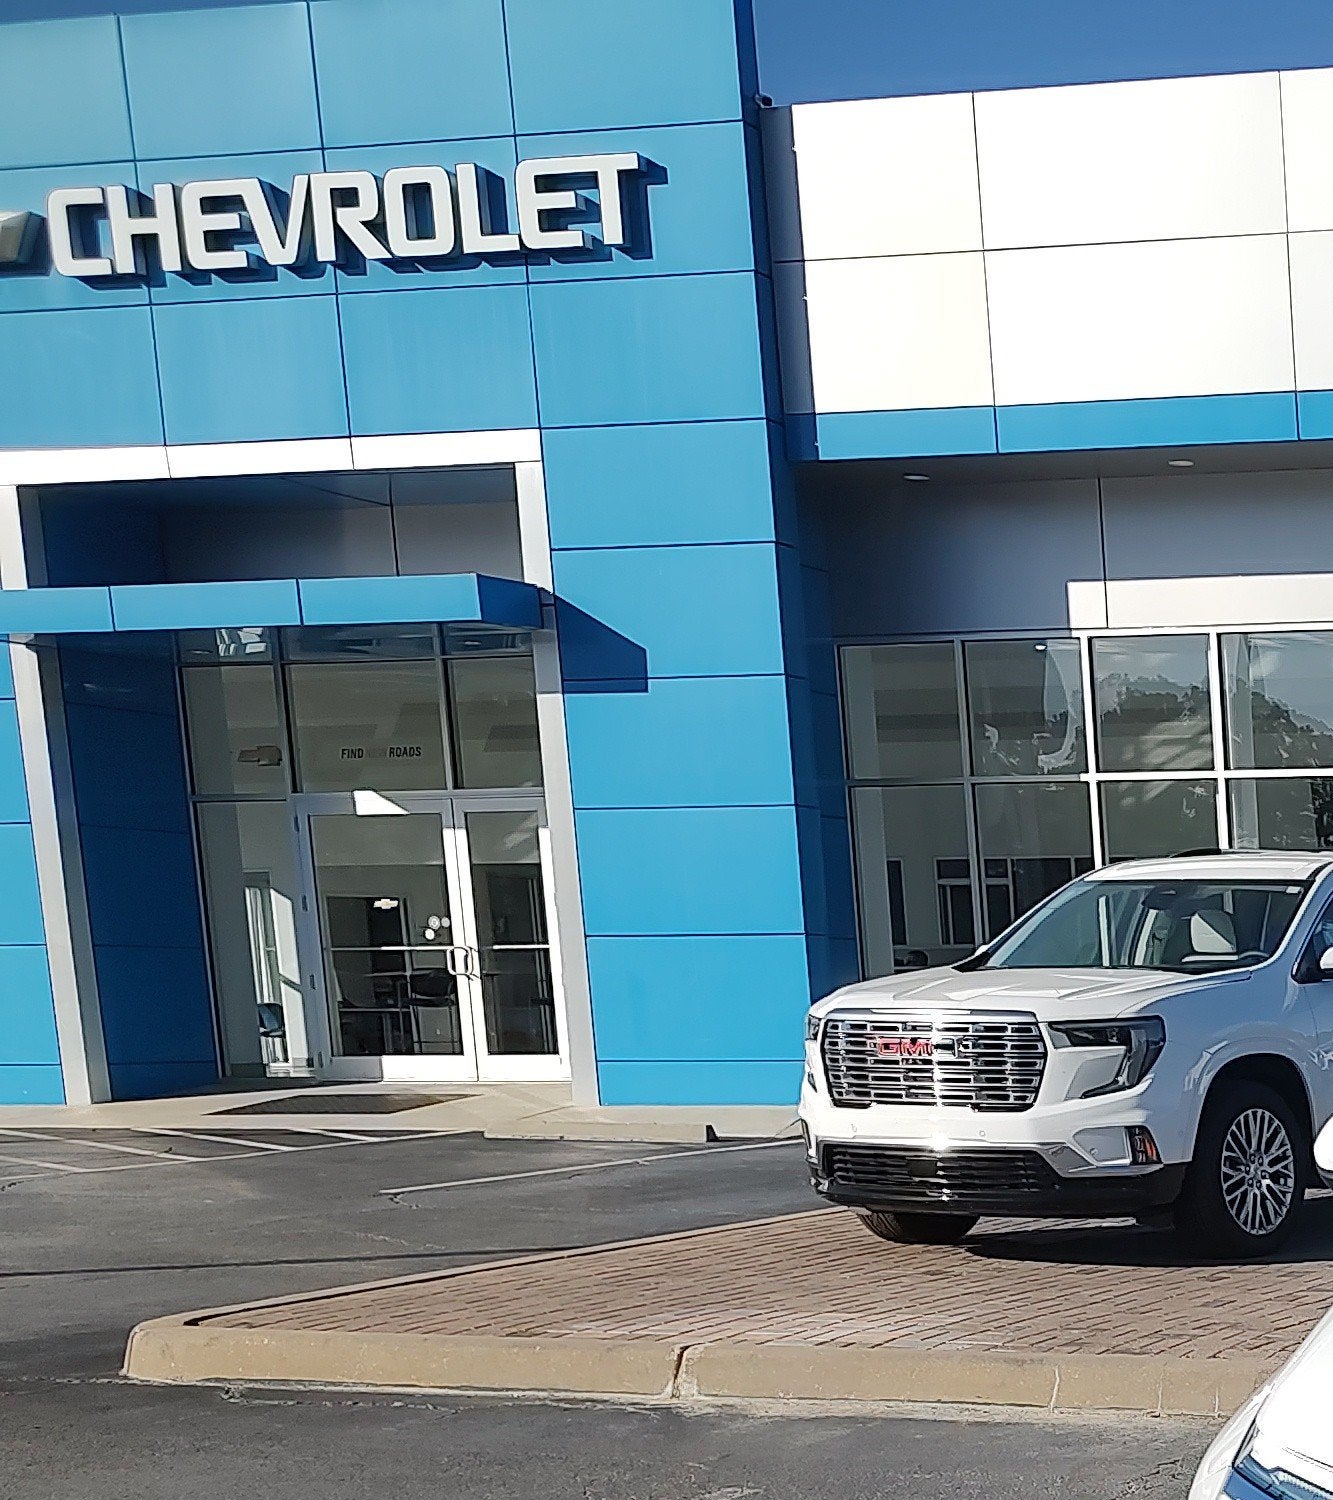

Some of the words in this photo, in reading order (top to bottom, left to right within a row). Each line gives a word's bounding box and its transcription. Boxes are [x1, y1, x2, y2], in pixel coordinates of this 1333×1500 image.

[47, 152, 640, 278] CHEVROLET
[341, 748, 364, 759] FIND
[389, 746, 422, 758] ROADS
